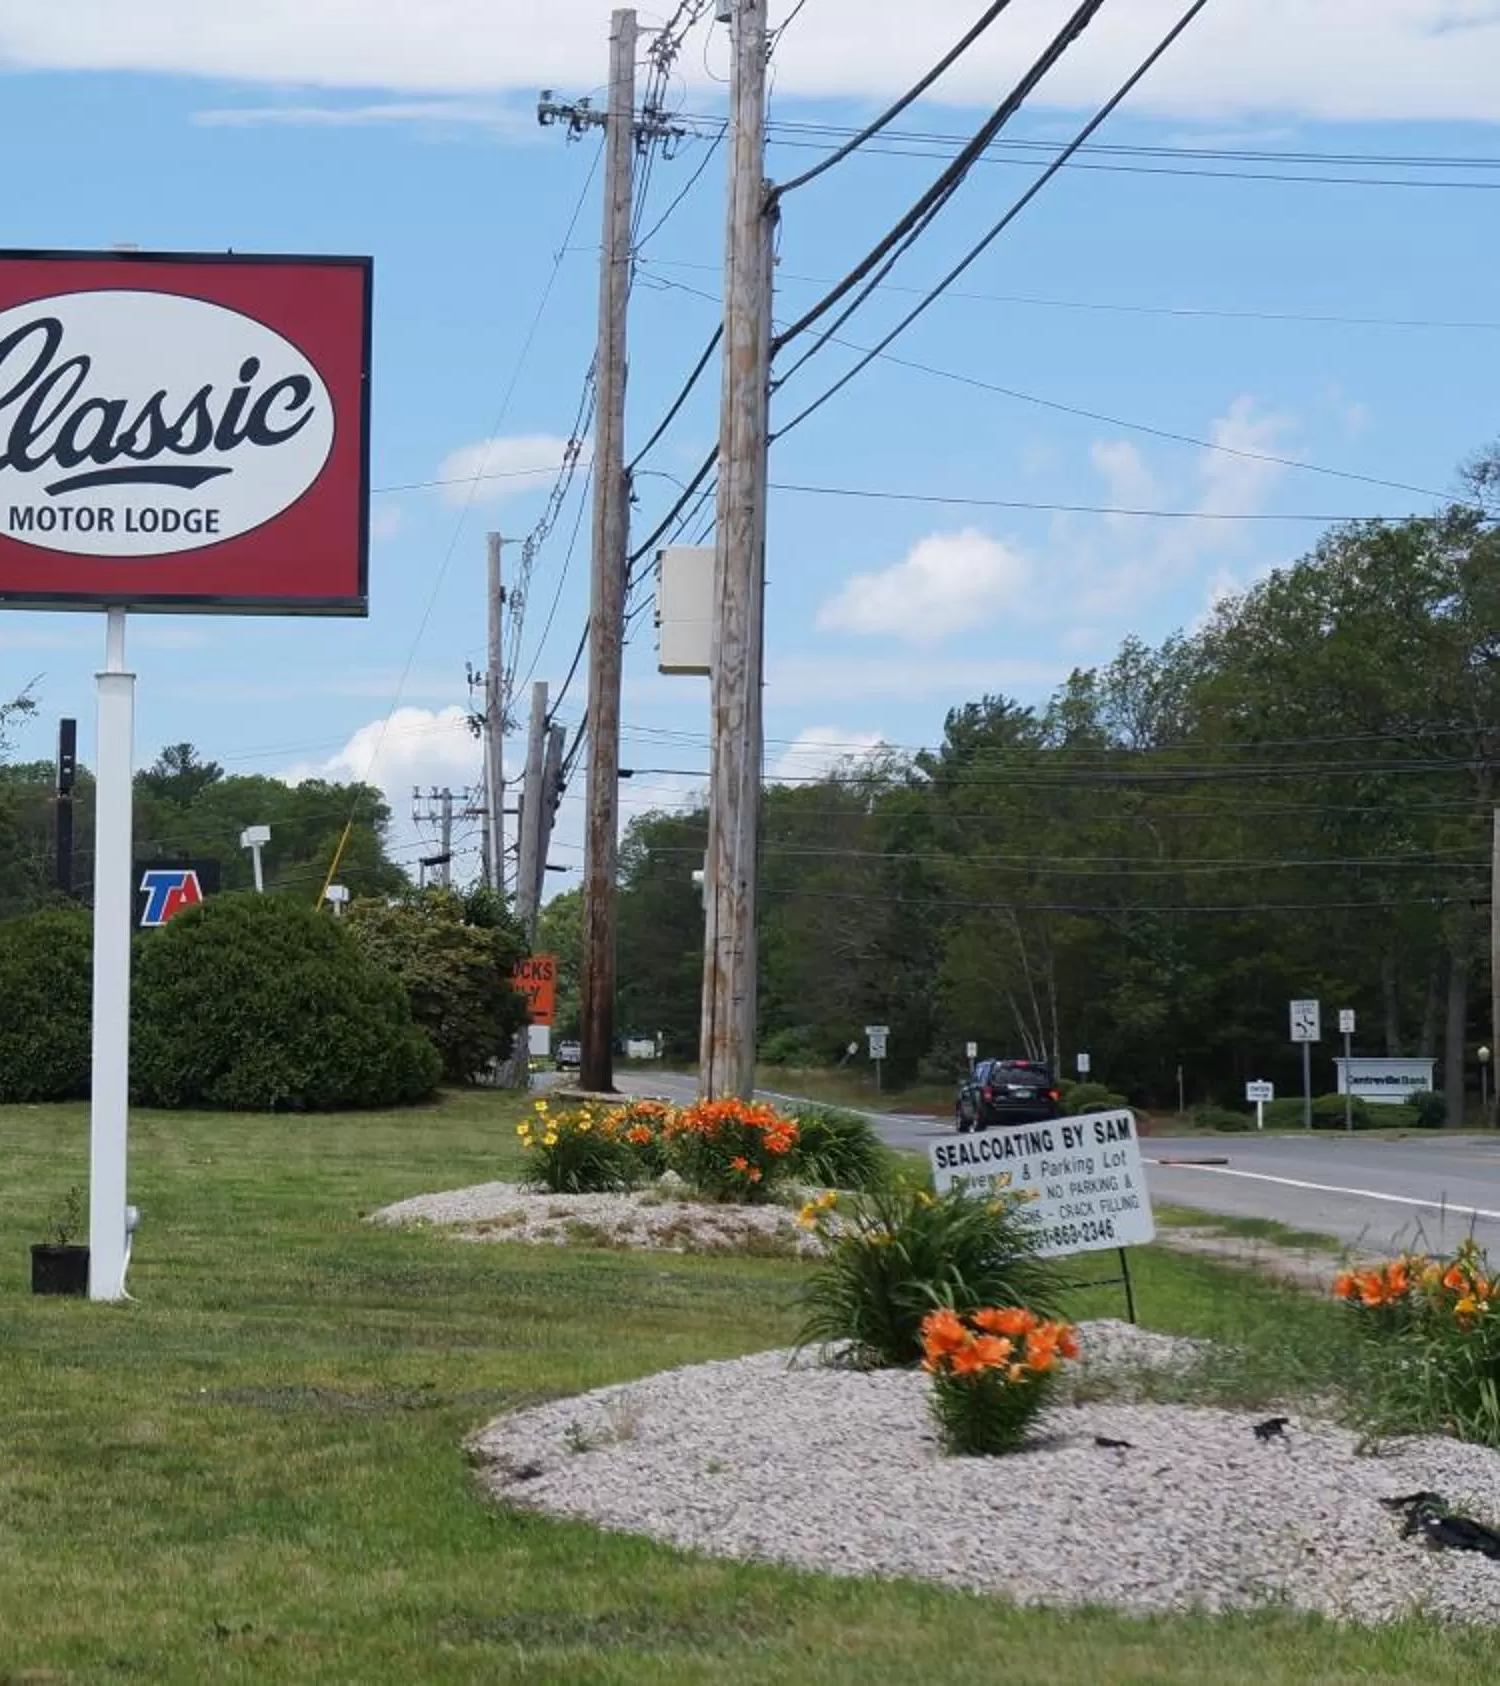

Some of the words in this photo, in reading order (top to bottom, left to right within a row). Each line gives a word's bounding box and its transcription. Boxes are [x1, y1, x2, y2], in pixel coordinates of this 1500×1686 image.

[8, 505, 115, 532] MOTOR
[125, 507, 220, 533] LODGE
[140, 869, 203, 926] TA
[935, 1129, 1054, 1169] SEALCOATING
[1061, 1124, 1084, 1149] BY
[1093, 1117, 1132, 1145] SAM
[1021, 1163, 1031, 1181] &
[1041, 1154, 1094, 1178] Parking
[1103, 1149, 1127, 1169] Lot
[1047, 1184, 1064, 1199] NO
[1069, 1175, 1119, 1195] PARKING
[1059, 1201, 1095, 1219] CRACK
[1100, 1194, 1140, 1213] FILLING
